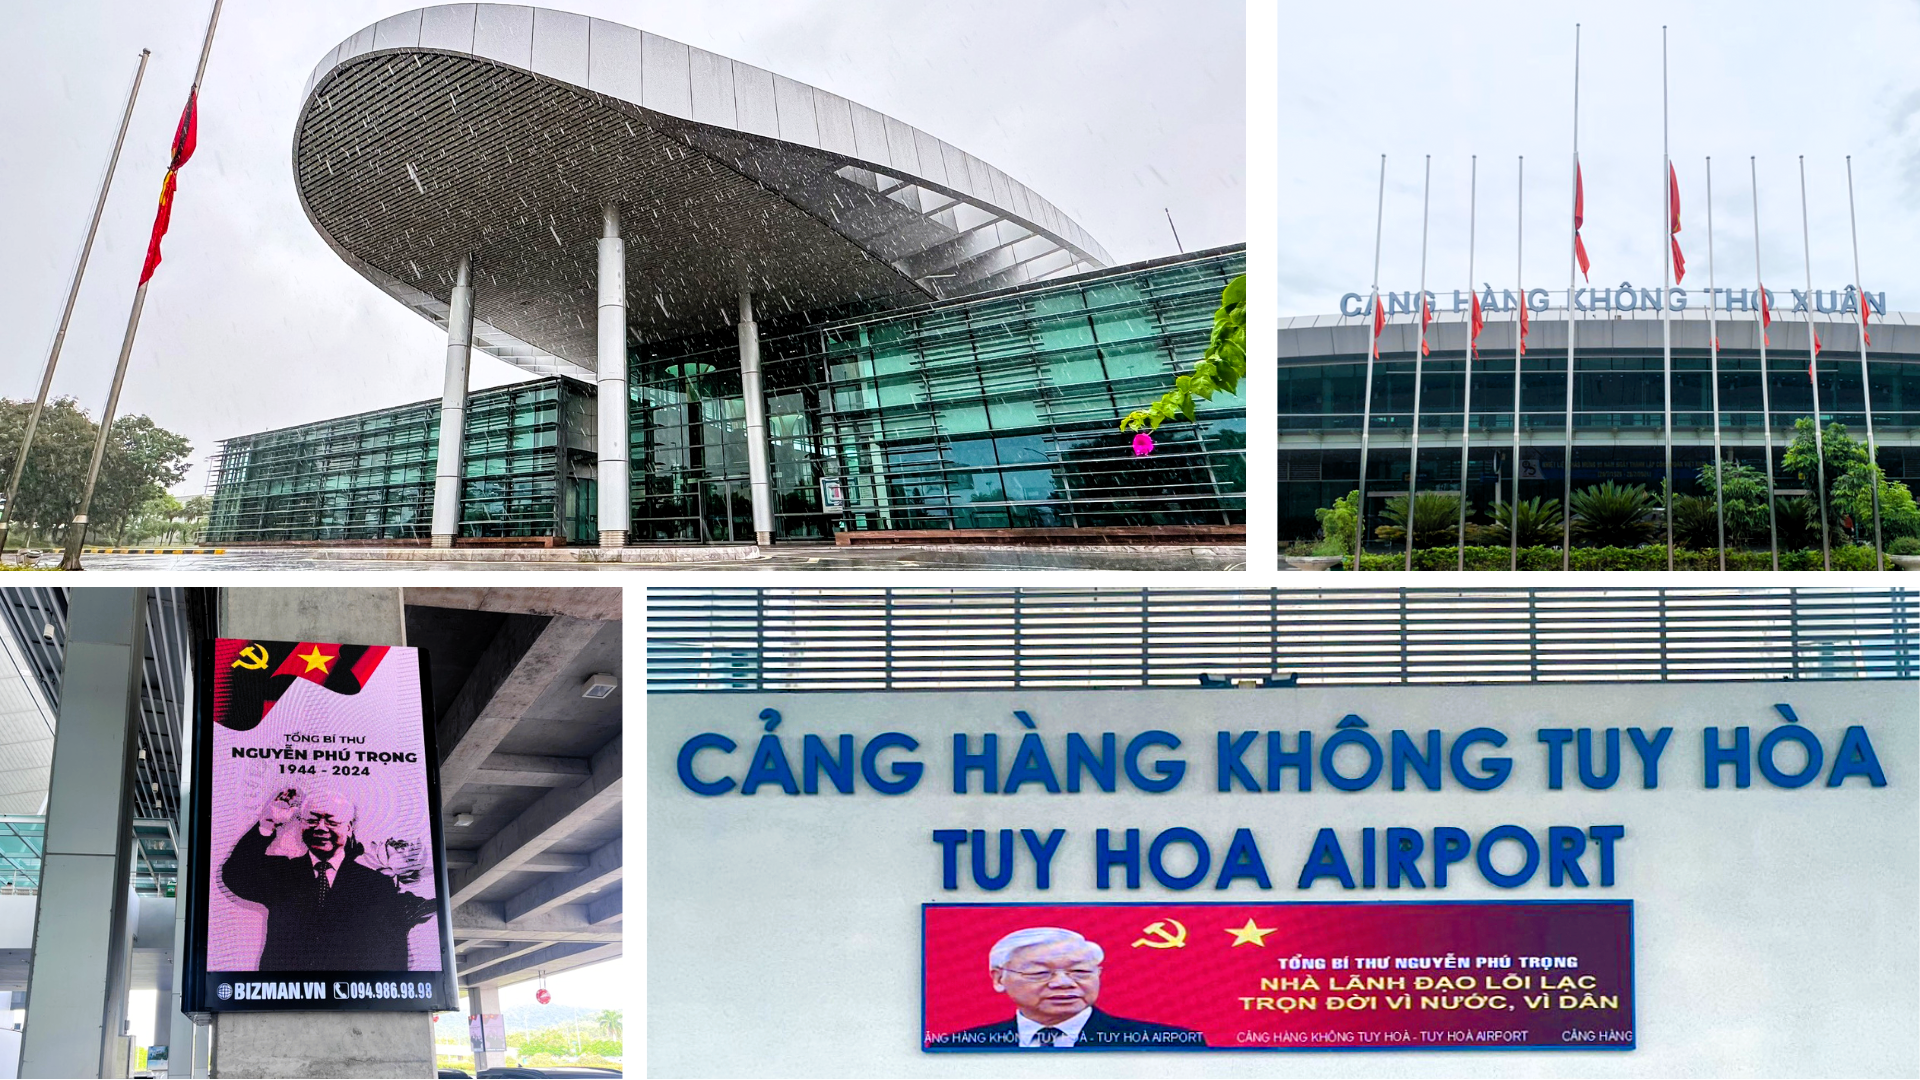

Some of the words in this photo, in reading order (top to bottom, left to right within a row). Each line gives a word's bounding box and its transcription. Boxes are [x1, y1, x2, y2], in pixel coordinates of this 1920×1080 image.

[1453, 282, 1549, 314] HÀNG
[1567, 281, 1687, 312] KHÔNG
[1791, 284, 1886, 316] XUÂN
[284, 731, 320, 743] TỔNG
[323, 734, 336, 744] BÍ
[340, 735, 366, 745] THƯ
[231, 744, 308, 761] NGUYỄN
[313, 748, 350, 762] PHÚ
[355, 751, 418, 766] TRỌNG
[676, 708, 924, 796] CẢNG
[953, 710, 1187, 794] HÀNG
[1217, 714, 1513, 793] KHÔNG
[1538, 726, 1674, 790] TUY
[1704, 703, 1888, 789] HÒA
[279, 764, 317, 775] 1944
[332, 765, 371, 776] 2024
[933, 828, 1066, 890] TUY
[1096, 826, 1273, 890] HOA
[1298, 825, 1625, 889] AIRPORT
[1278, 953, 1326, 970] TỔNG
[1331, 956, 1350, 970] BÍ
[1354, 956, 1391, 970] THƯ
[1395, 952, 1470, 970] NGUYỄN
[1476, 955, 1512, 970] PHÚ
[1519, 956, 1578, 972] TRỌNG
[234, 982, 326, 1000] BIZMAN.VN
[350, 982, 433, 999] 094.986.98.98
[1260, 973, 1321, 991] NHÀ
[1329, 973, 1405, 991] LÃNH
[1413, 975, 1477, 993] ĐẠO
[1540, 975, 1597, 993] LẠC
[1239, 996, 1317, 1014] TRỌN
[1326, 993, 1378, 1011] ĐỜI
[1384, 993, 1412, 1010] VÌ
[1420, 993, 1515, 1012] NƯỚC,
[1523, 992, 1551, 1010] VÌ
[1559, 993, 1619, 1010] DÂN
[952, 1030, 987, 1043] HÀNG
[989, 1030, 1026, 1043] KHÔN
[1097, 1032, 1120, 1043] TUY
[1123, 1030, 1150, 1043] HOÀ
[1152, 1031, 1204, 1043] AIRPORT
[1236, 1030, 1270, 1043] CẢNG
[1273, 1030, 1308, 1043] HÀNG
[1311, 1030, 1355, 1043] KHÔNG
[1358, 1031, 1381, 1043] TUY
[1385, 1030, 1411, 1043] HOÀ
[1421, 1031, 1442, 1043] TUY
[1447, 1030, 1474, 1043] HOÀ
[1476, 1031, 1528, 1043] AIRPORT
[1562, 1029, 1596, 1042] CẢNG
